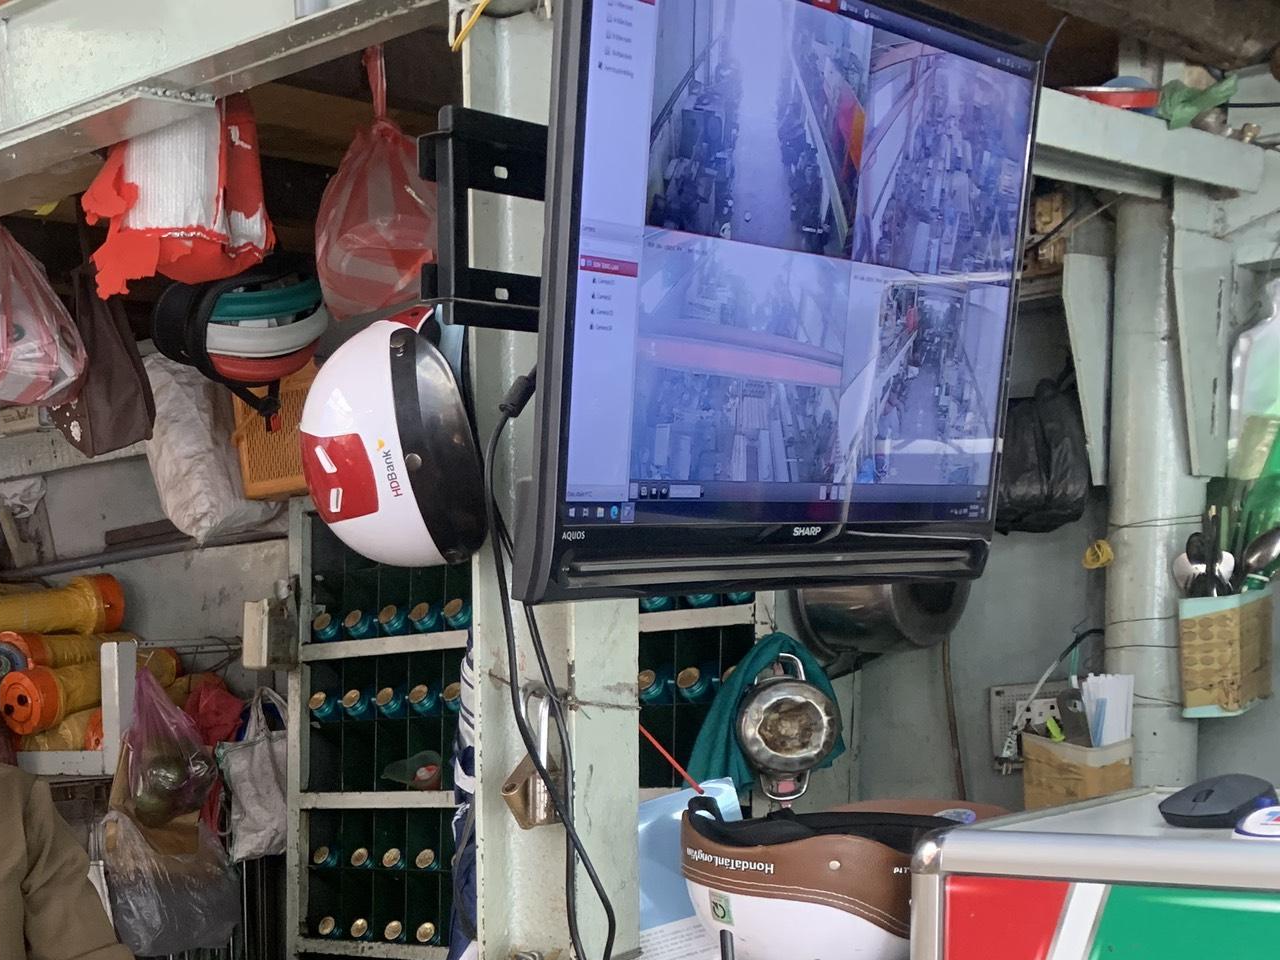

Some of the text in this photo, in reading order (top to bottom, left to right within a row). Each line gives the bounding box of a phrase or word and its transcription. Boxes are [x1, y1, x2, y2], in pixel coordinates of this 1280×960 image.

[383, 449, 403, 498] HDBank
[562, 531, 586, 541] AQUOS
[793, 527, 821, 536] SHARP
